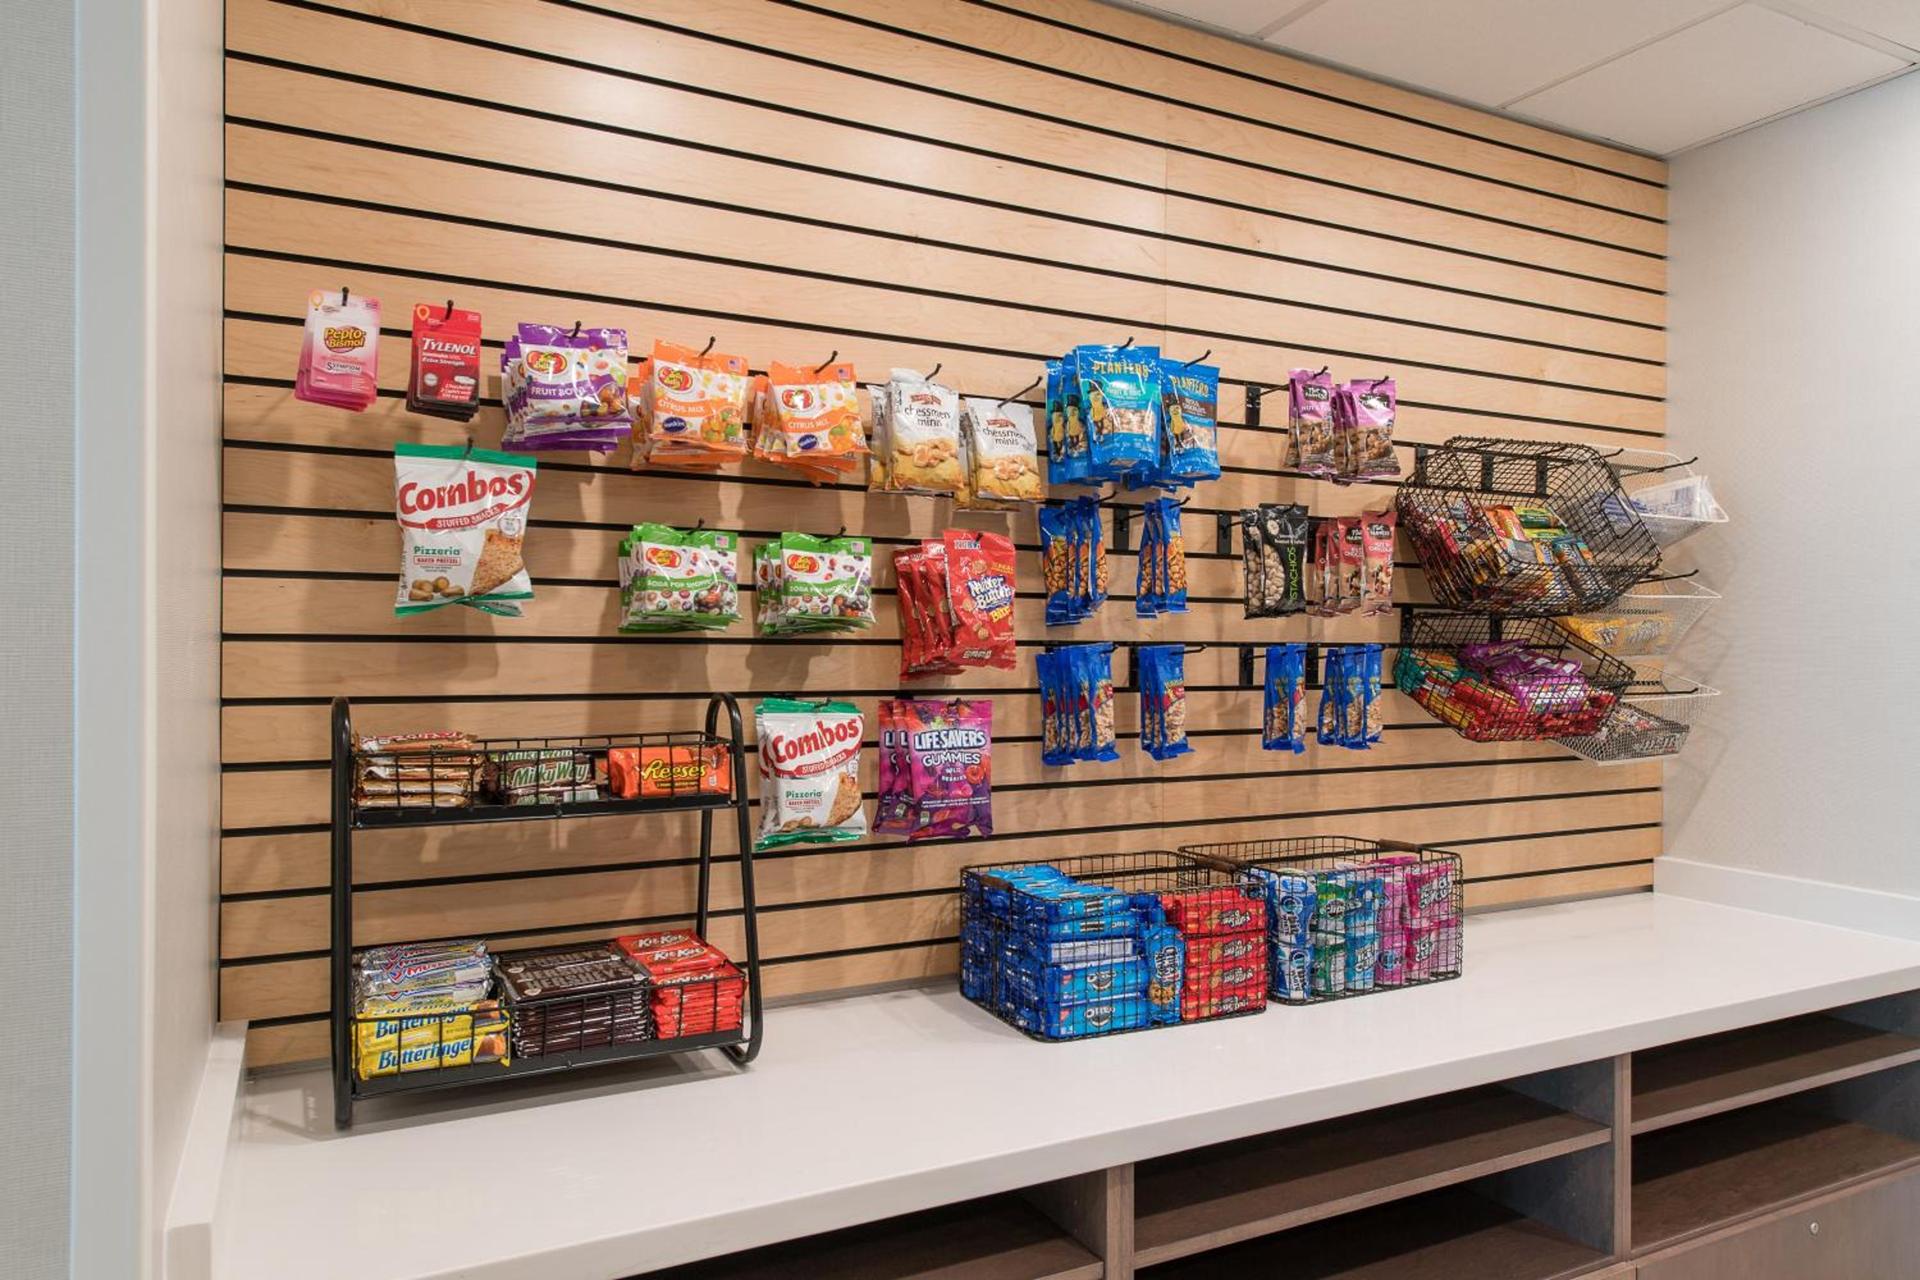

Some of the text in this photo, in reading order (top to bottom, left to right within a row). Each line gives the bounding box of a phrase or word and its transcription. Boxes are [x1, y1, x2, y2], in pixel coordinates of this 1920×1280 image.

[324, 326, 367, 341] Pepto-
[328, 337, 364, 348] Bismol
[422, 337, 476, 355] TYLENOL
[531, 386, 557, 395] FRUIT
[983, 427, 1027, 441] chessmen
[995, 437, 1020, 446] minis
[399, 470, 523, 515] Combos
[436, 506, 500, 529] STUFFED SNACKS
[413, 545, 460, 556] Pizzeria
[1287, 546, 1299, 602] ISTACHIOS
[968, 576, 1004, 597] Nutter
[772, 719, 859, 763] Combos
[923, 751, 981, 767] GUMMIES
[511, 760, 591, 789] Milky Way
[641, 759, 707, 780] Reeses
[786, 789, 822, 799] Pizzeria
[654, 947, 705, 961] Kit Kat
